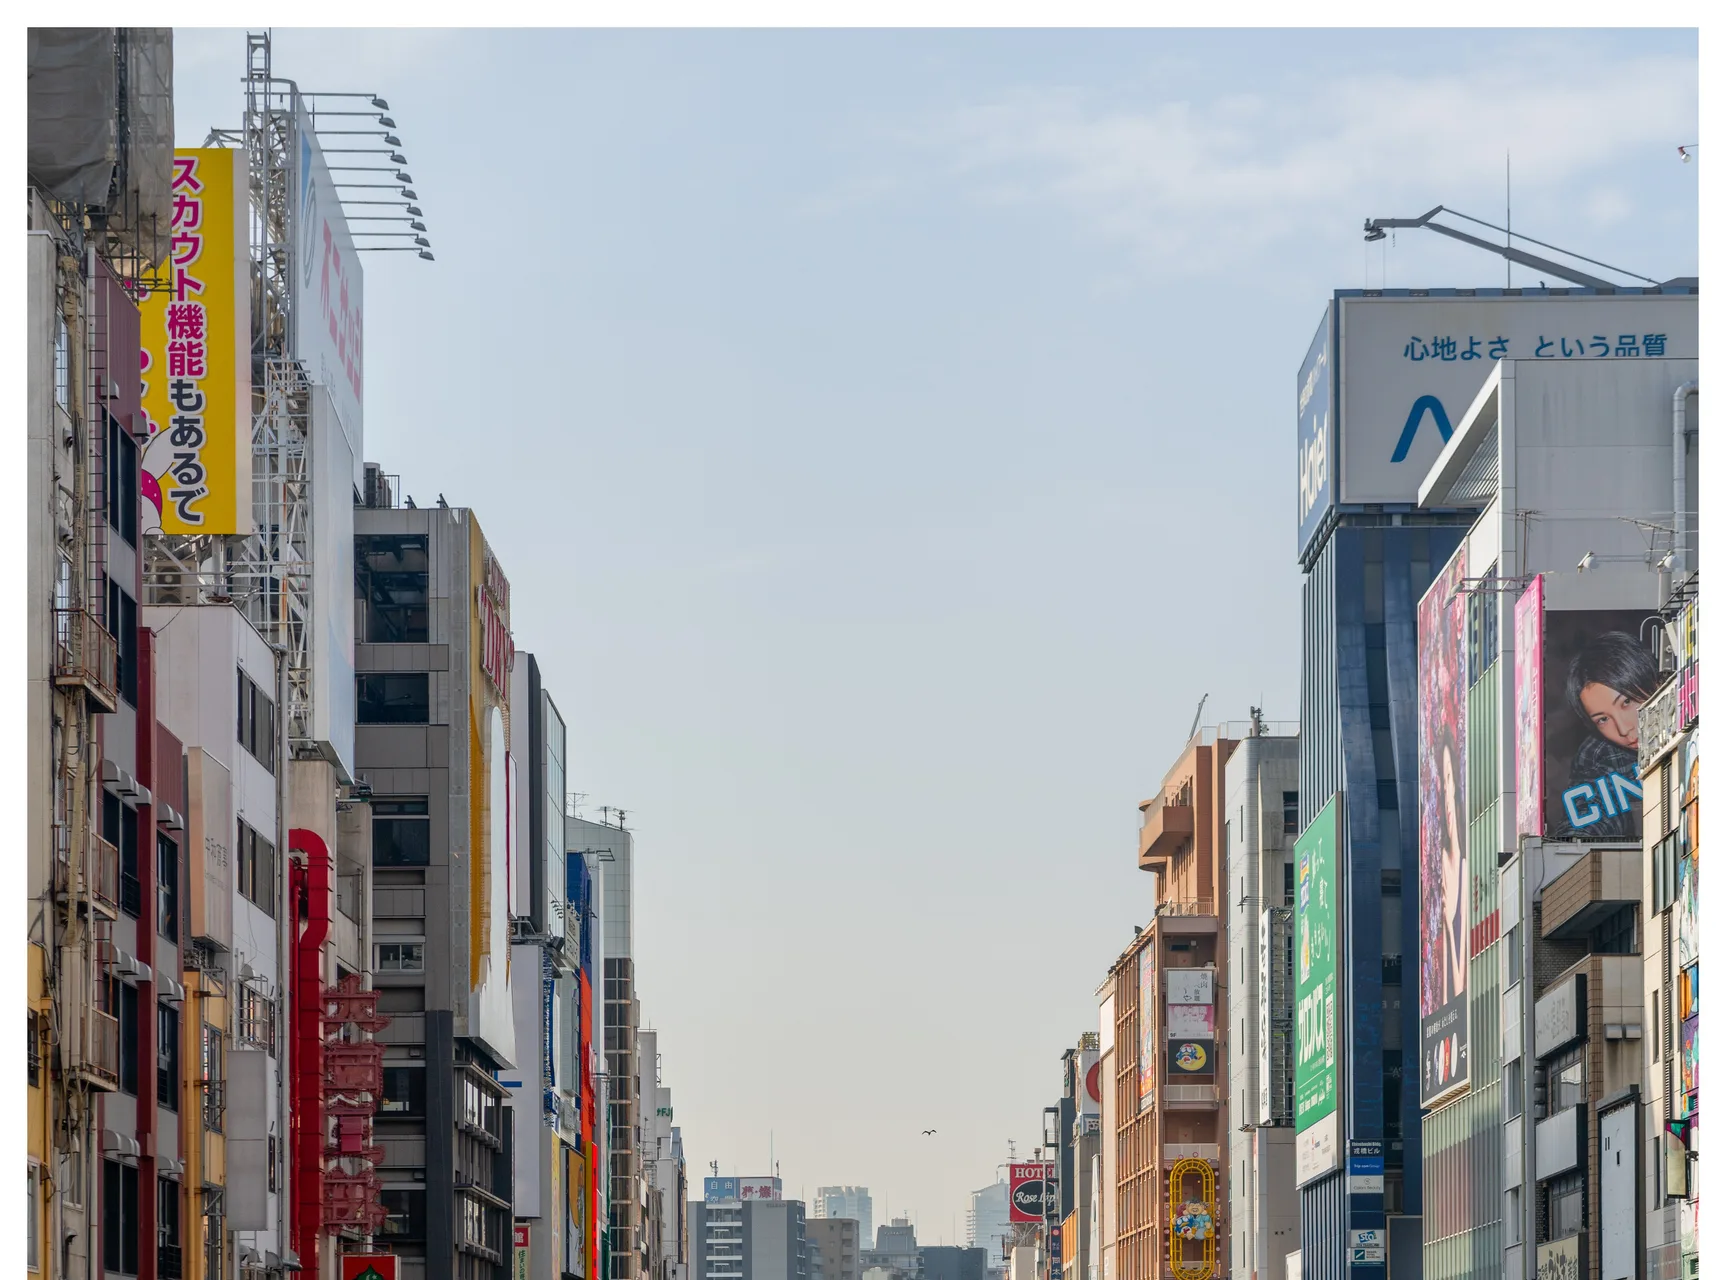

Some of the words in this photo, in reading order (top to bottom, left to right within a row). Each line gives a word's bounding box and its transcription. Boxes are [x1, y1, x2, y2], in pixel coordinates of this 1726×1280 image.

[168, 158, 204, 521] スカウト機能もあるで
[1403, 336, 1509, 361] 心地よさ
[1534, 334, 1668, 357] という品質
[1300, 411, 1328, 527] Haier
[1015, 1191, 1037, 1204] Rose
